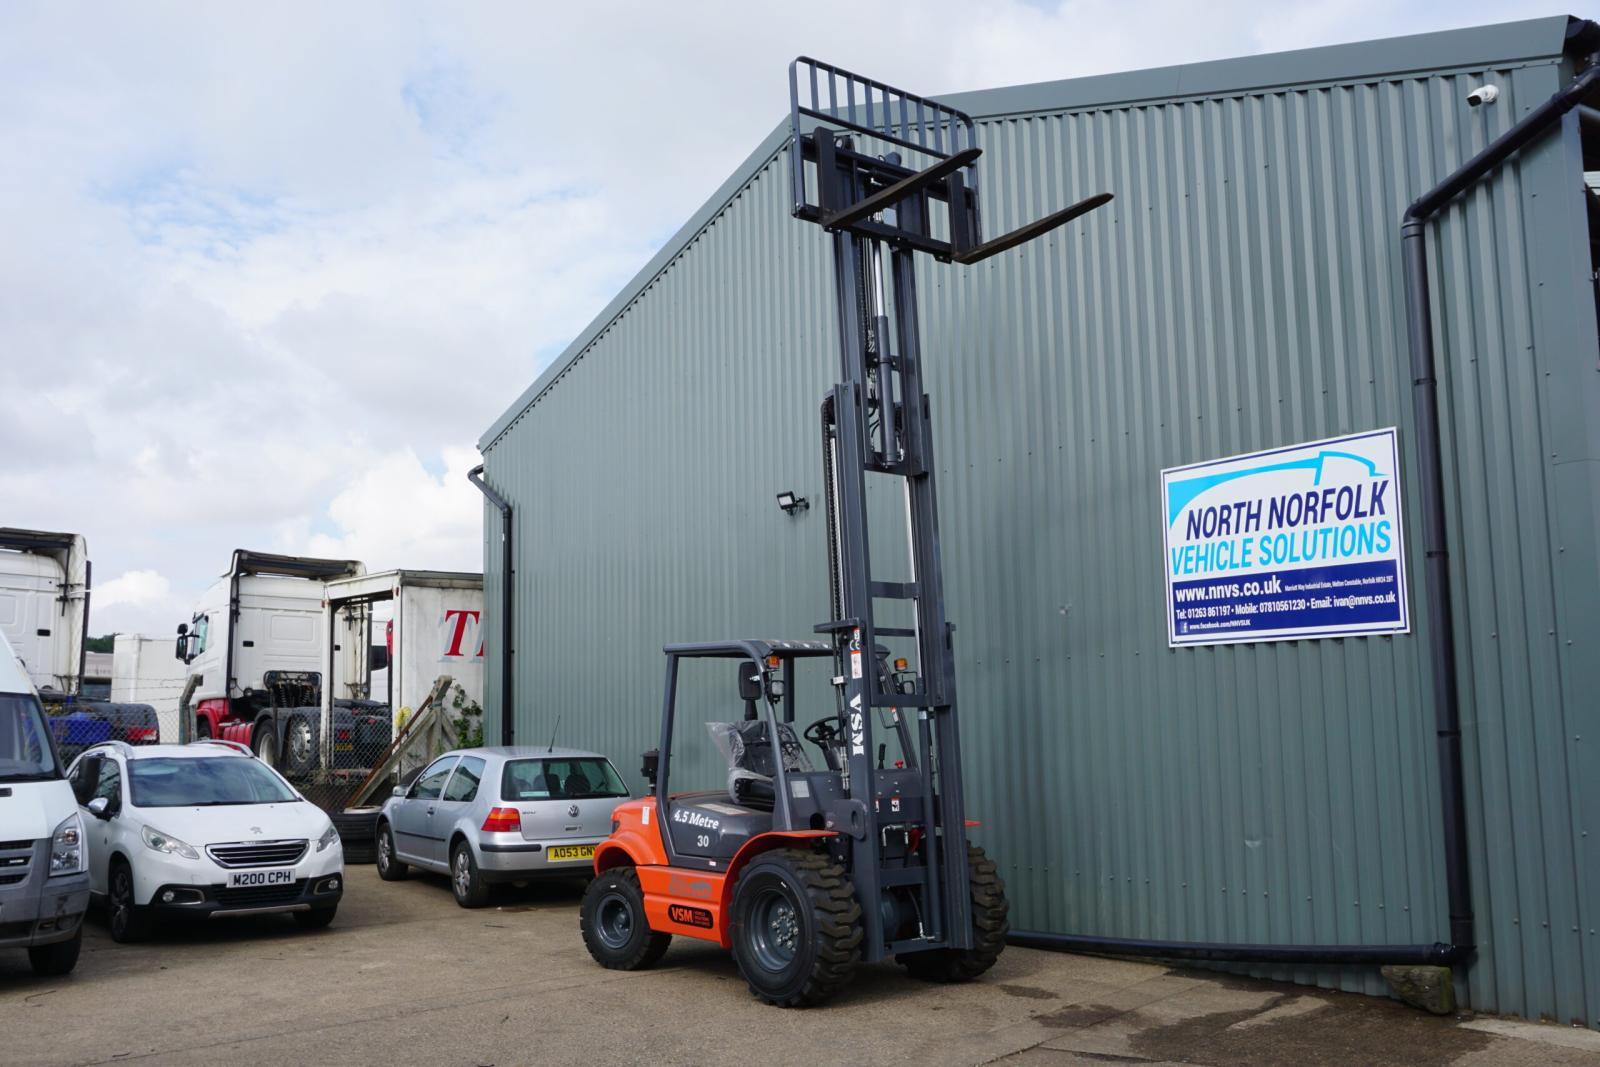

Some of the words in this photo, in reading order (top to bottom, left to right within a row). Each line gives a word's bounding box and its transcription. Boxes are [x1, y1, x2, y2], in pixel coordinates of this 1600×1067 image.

[1186, 499, 1262, 541] NORTH
[1267, 480, 1389, 530] NORFOLK
[1172, 537, 1254, 576] VEHICLE
[1259, 520, 1391, 566] SOLUTIONS
[1175, 574, 1282, 603] www.nnvs.co.uk
[1176, 609, 1187, 620] Tel:
[1187, 606, 1207, 619] 01263
[1207, 604, 1231, 617] 861197
[1234, 602, 1258, 615] Mobile:
[1259, 598, 1306, 613] 07810561230
[1311, 595, 1332, 609] Email:
[1333, 590, 1396, 609] ivan@nnvs.co.uk
[850, 694, 864, 755] VSM
[688, 812, 720, 830] Metre
[697, 834, 710, 848] 30
[553, 847, 579, 859] AO53
[233, 872, 265, 886] M200
[268, 871, 291, 884] CPH
[671, 906, 694, 923] VSM
